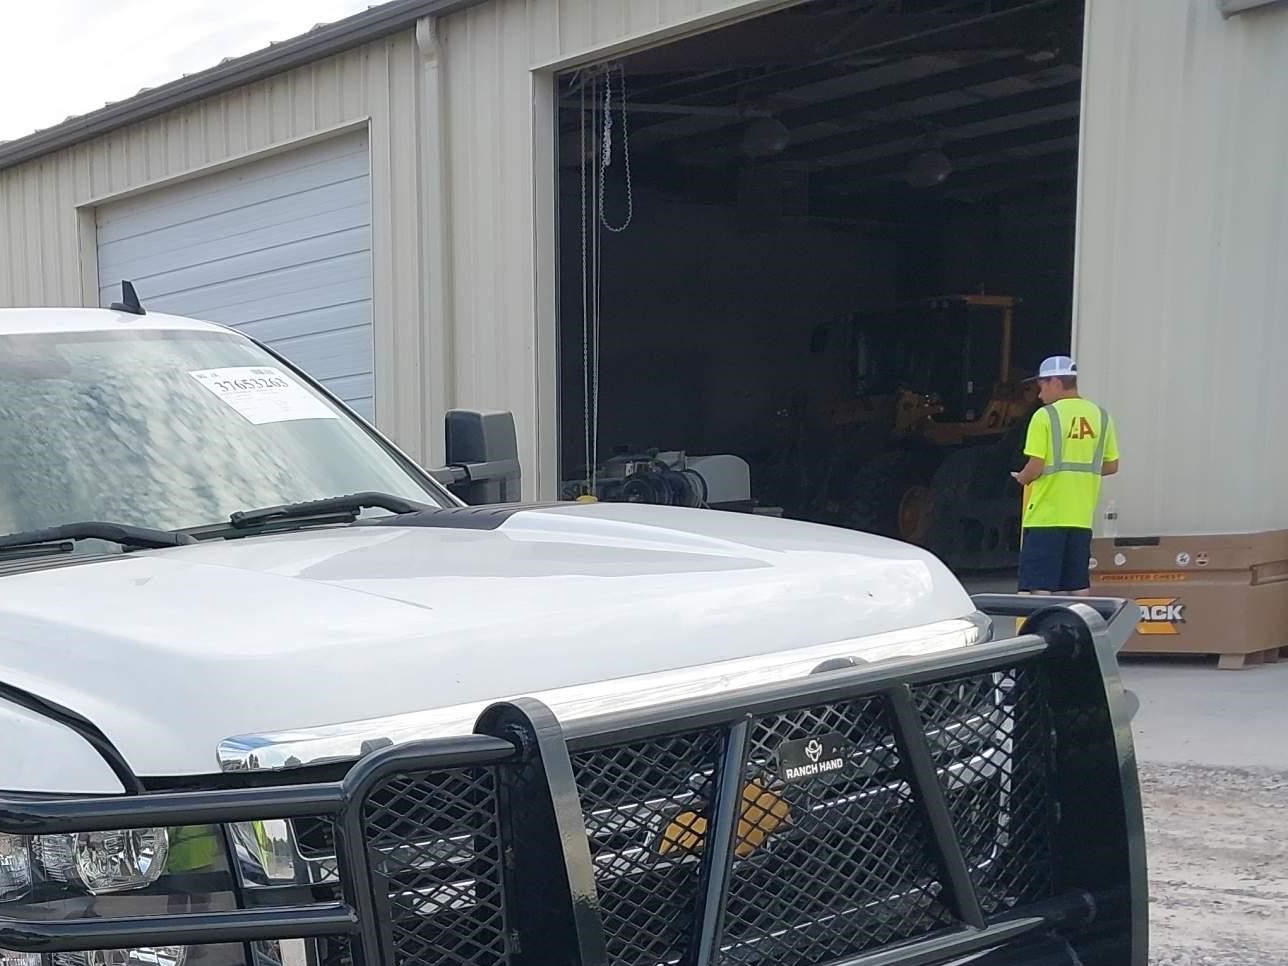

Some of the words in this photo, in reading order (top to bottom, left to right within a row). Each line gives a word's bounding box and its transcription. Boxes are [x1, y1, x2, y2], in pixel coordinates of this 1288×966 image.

[214, 377, 289, 392] 37653263
[1139, 605, 1185, 620] ACK
[786, 763, 818, 779] RANCH
[819, 758, 843, 772] HAND
